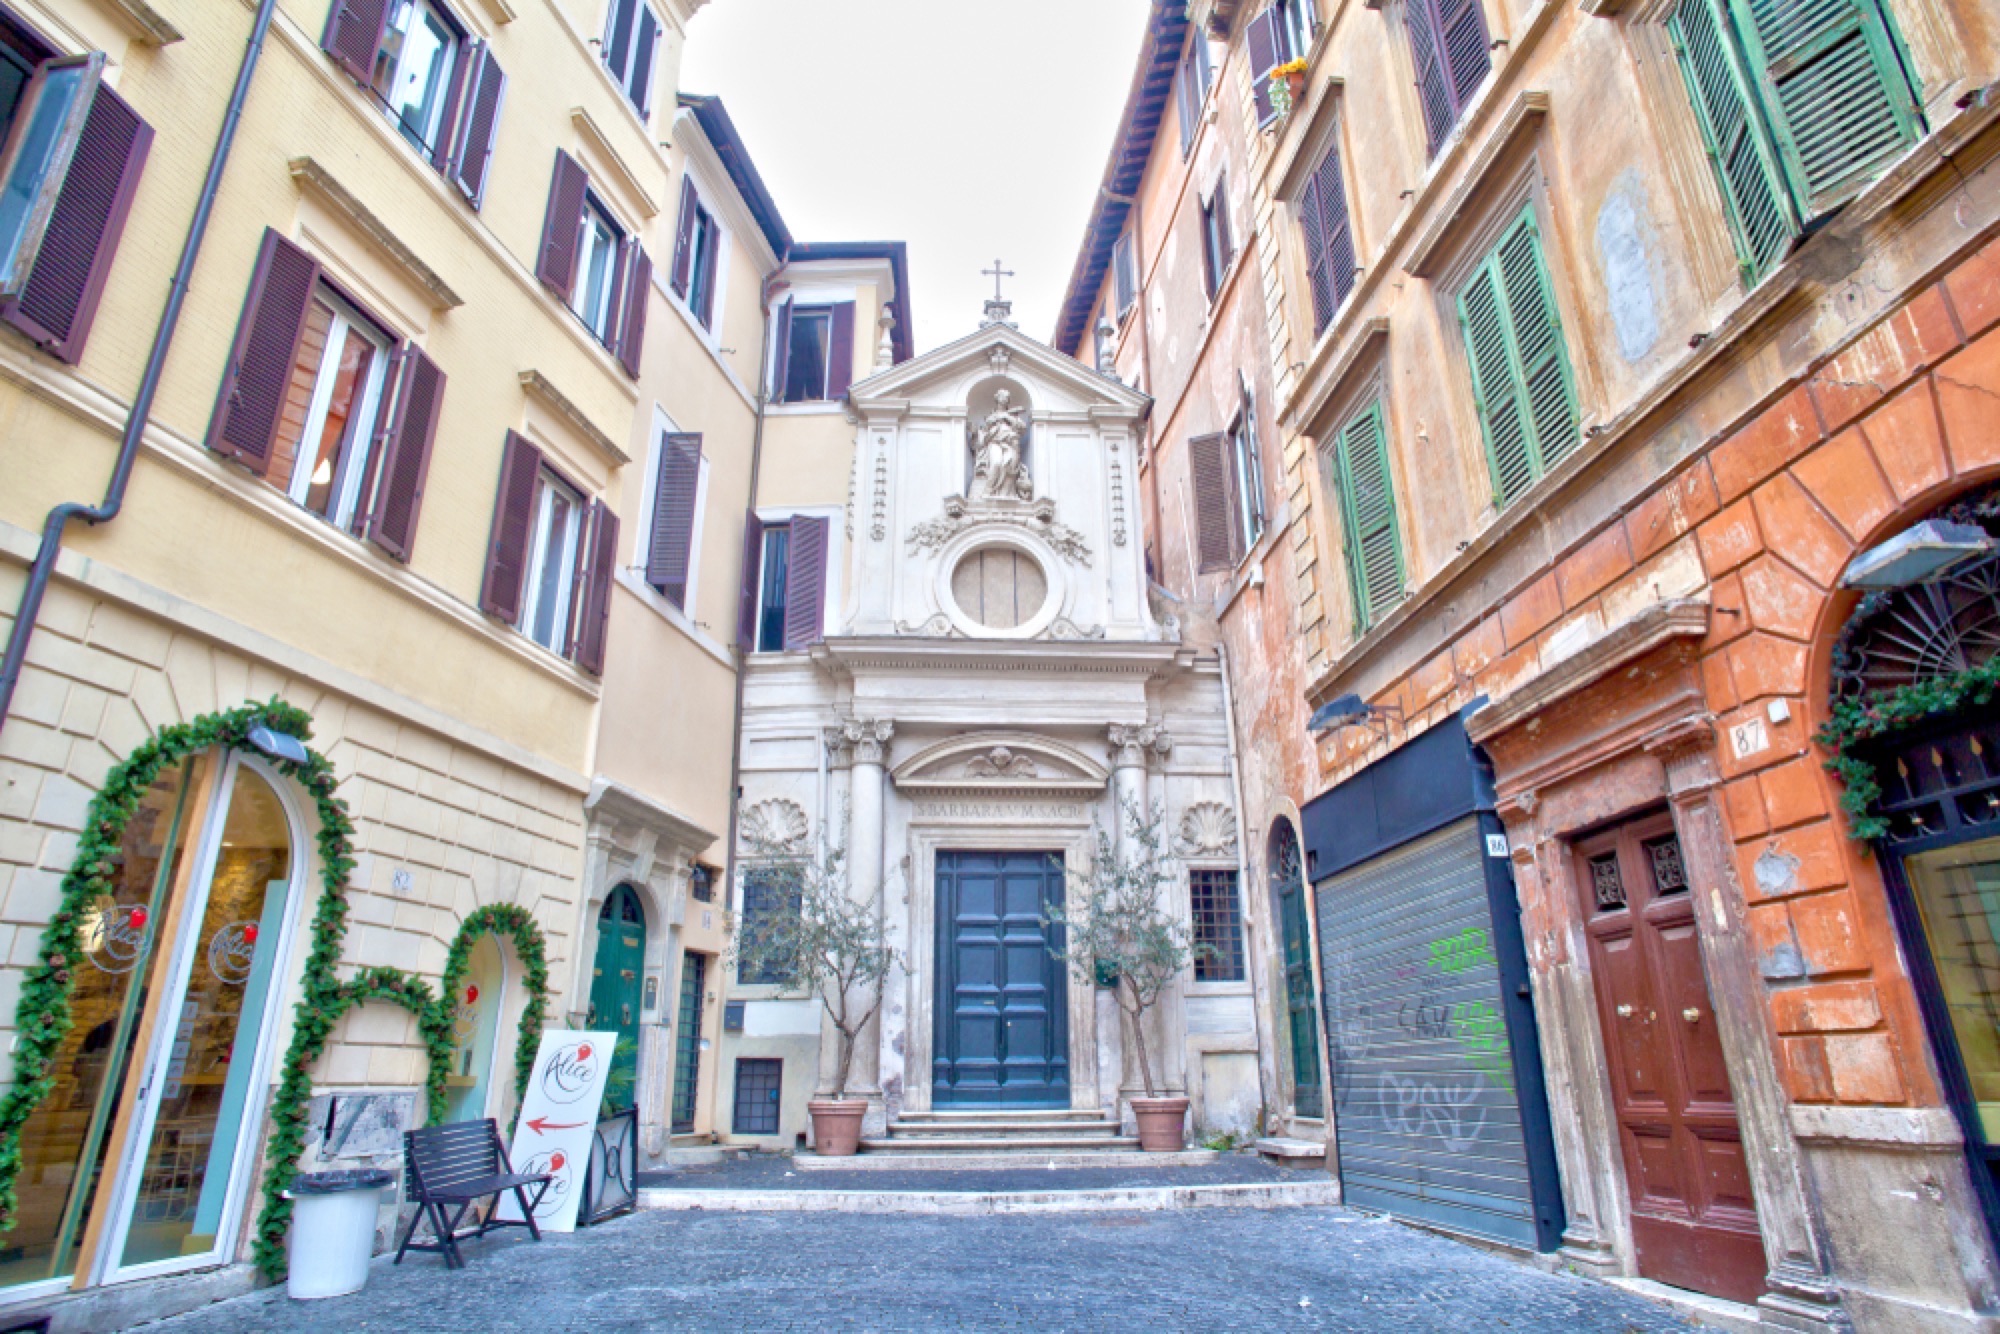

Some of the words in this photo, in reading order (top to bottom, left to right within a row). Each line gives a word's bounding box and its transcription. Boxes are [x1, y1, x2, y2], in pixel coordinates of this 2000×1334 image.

[1735, 720, 1759, 753] 87
[544, 1051, 593, 1092] Alice
[520, 1159, 568, 1205] Alce
